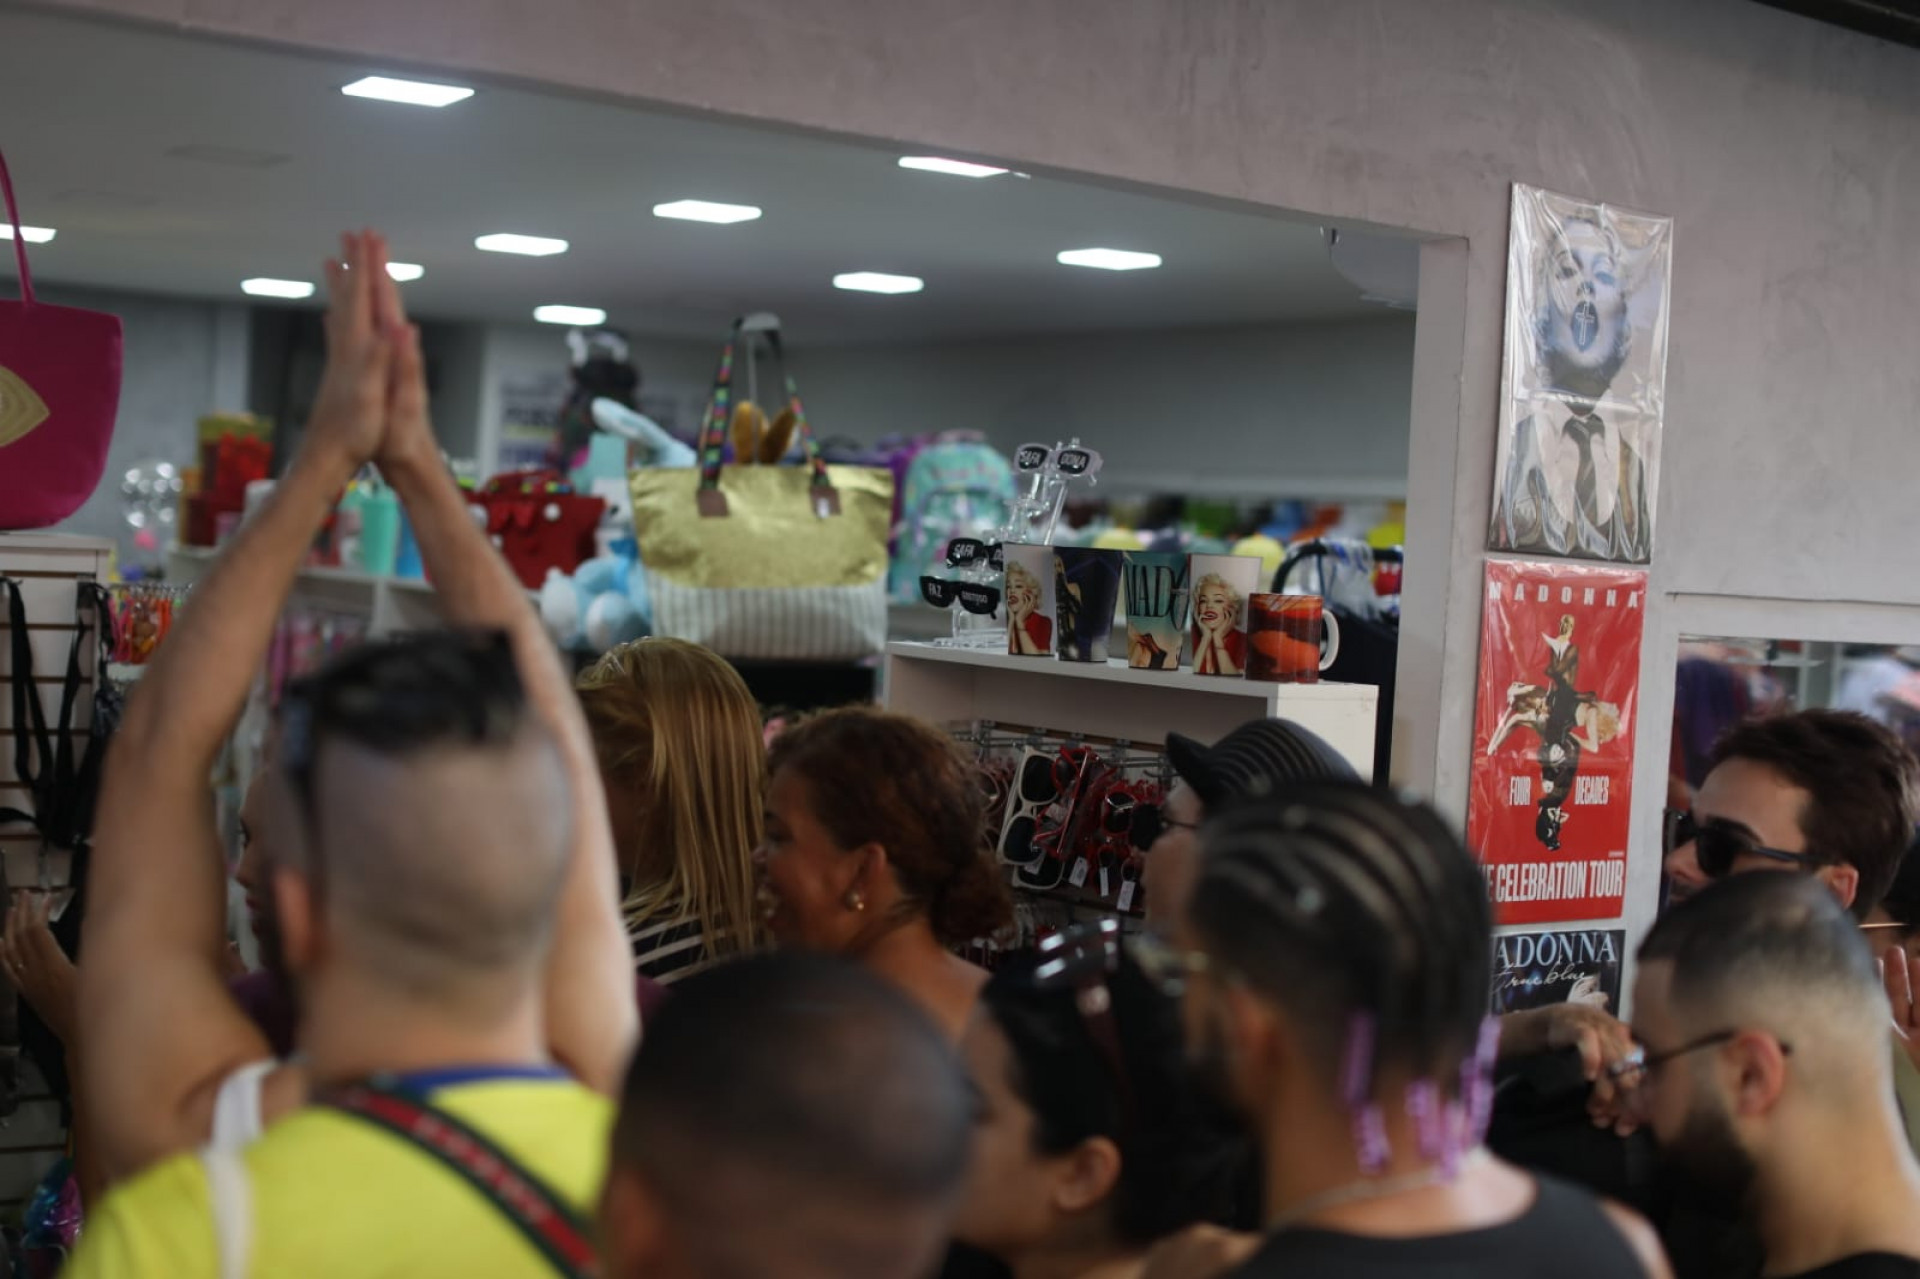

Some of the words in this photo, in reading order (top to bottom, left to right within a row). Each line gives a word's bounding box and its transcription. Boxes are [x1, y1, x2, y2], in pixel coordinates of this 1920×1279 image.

[928, 582, 943, 598] FAZ
[1489, 581, 1640, 608] MADONNA
[1509, 775, 1532, 806] FOUR
[1574, 775, 1610, 806] DECADES
[1495, 860, 1588, 903] CELEBRATION
[1589, 859, 1625, 899] TOUR
[1496, 931, 1617, 968] ADONNA
